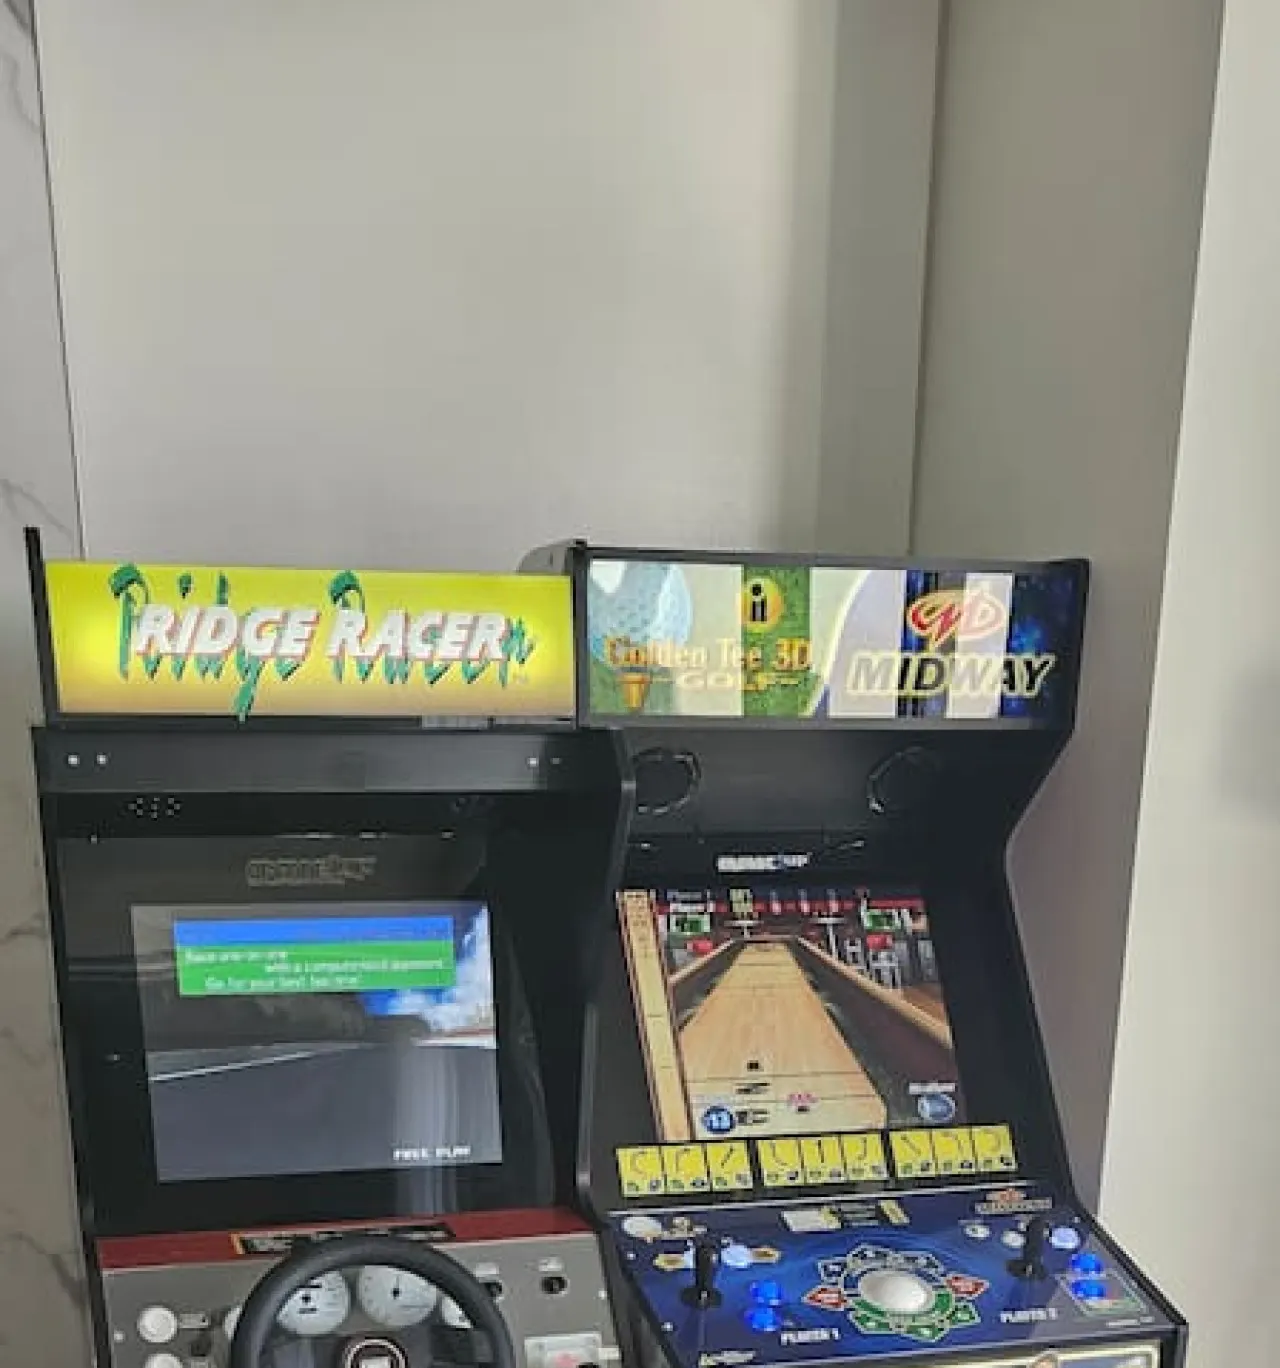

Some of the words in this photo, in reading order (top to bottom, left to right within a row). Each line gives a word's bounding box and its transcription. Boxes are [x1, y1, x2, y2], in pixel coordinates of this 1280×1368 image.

[136, 602, 320, 658] RIDGE
[327, 606, 513, 662] RACER
[714, 636, 764, 672] Tee
[772, 636, 814, 672] 3D
[847, 652, 1056, 698] MIDWAY
